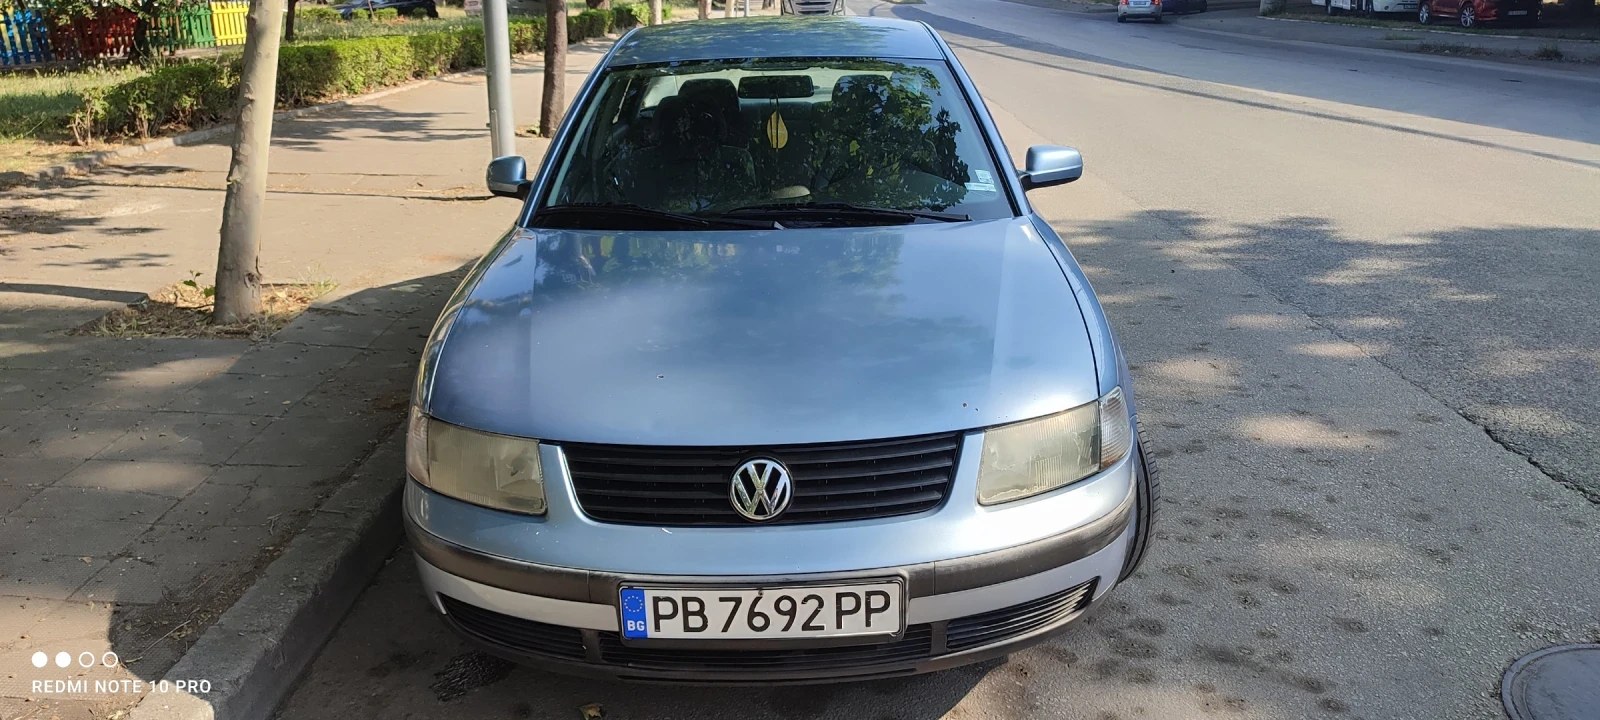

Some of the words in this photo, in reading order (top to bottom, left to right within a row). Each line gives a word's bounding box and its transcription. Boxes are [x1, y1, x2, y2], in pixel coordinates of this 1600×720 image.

[652, 596, 709, 633] PB
[718, 595, 826, 633] 7692
[835, 590, 891, 630] PP
[627, 620, 645, 631] BG
